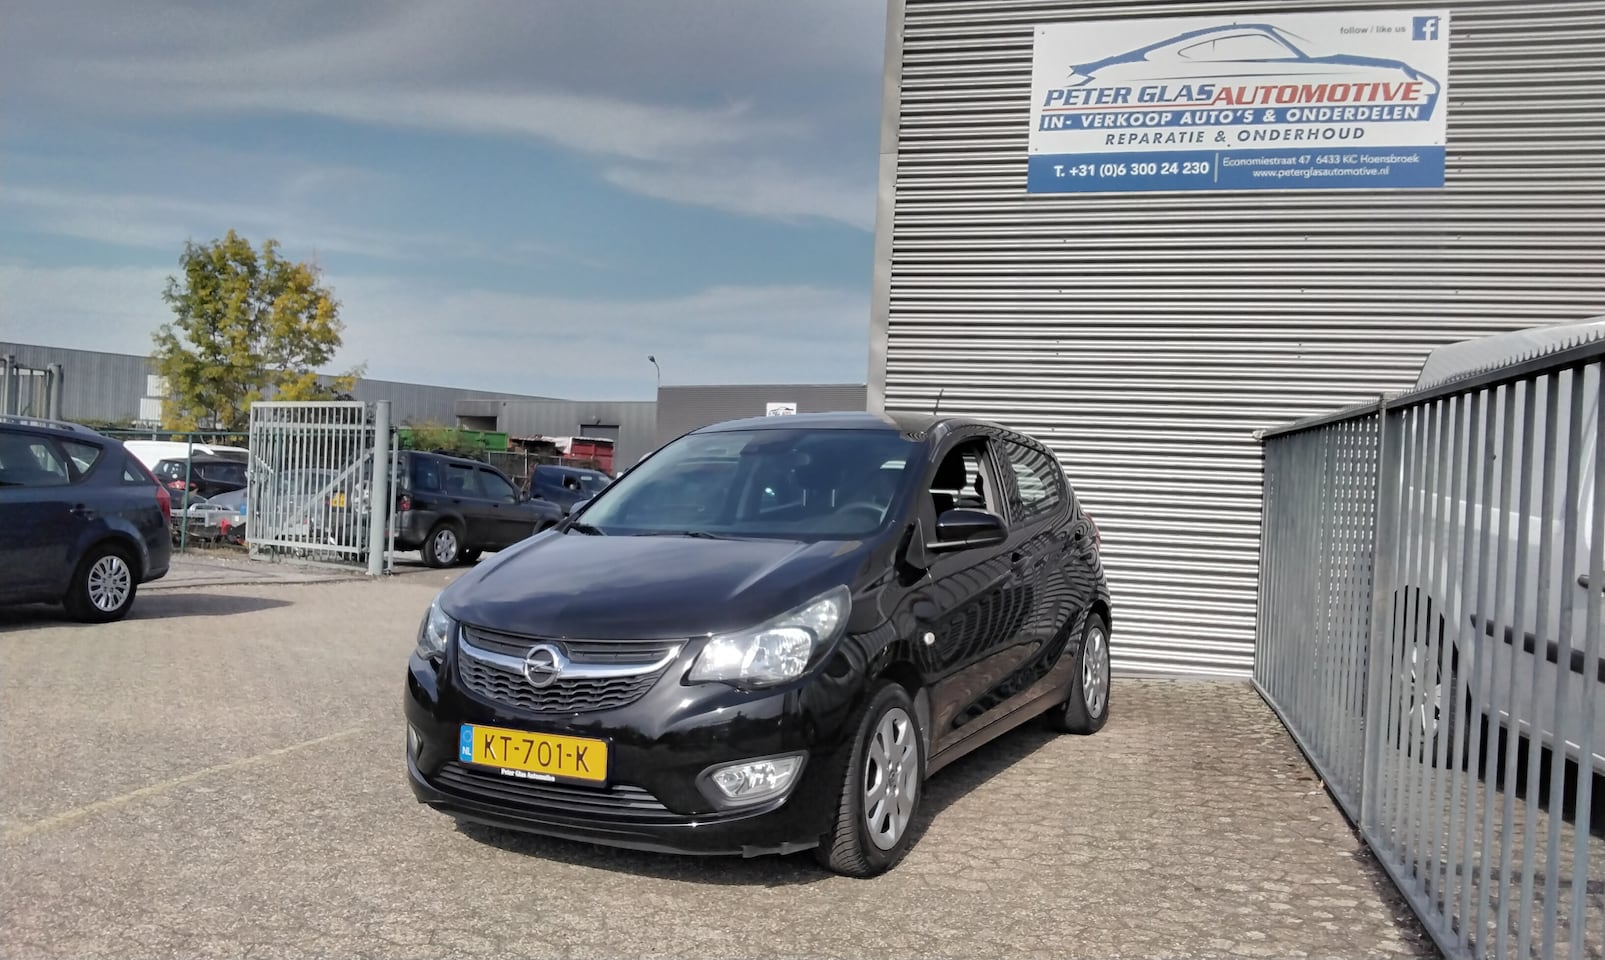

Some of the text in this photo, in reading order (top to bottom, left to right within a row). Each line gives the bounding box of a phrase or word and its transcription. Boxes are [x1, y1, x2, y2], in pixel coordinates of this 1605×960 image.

[1340, 26, 1368, 34] follow
[1376, 25, 1392, 33] like
[1043, 86, 1132, 107] PETER
[1043, 106, 1420, 129] IN- VERKOOP AUTO'S & ONDERDELEN
[1105, 127, 1365, 145] REPARATIE & ONDERHOUD
[1223, 153, 1420, 167] Economiestraat 47 6433 KC Hoensbroek
[1054, 162, 1209, 178] T. +31 (0)6 300 24 230
[1252, 165, 1390, 178] www.peterglasautomotive.nl
[462, 746, 472, 756] NL
[484, 733, 590, 773] KT-701-K
